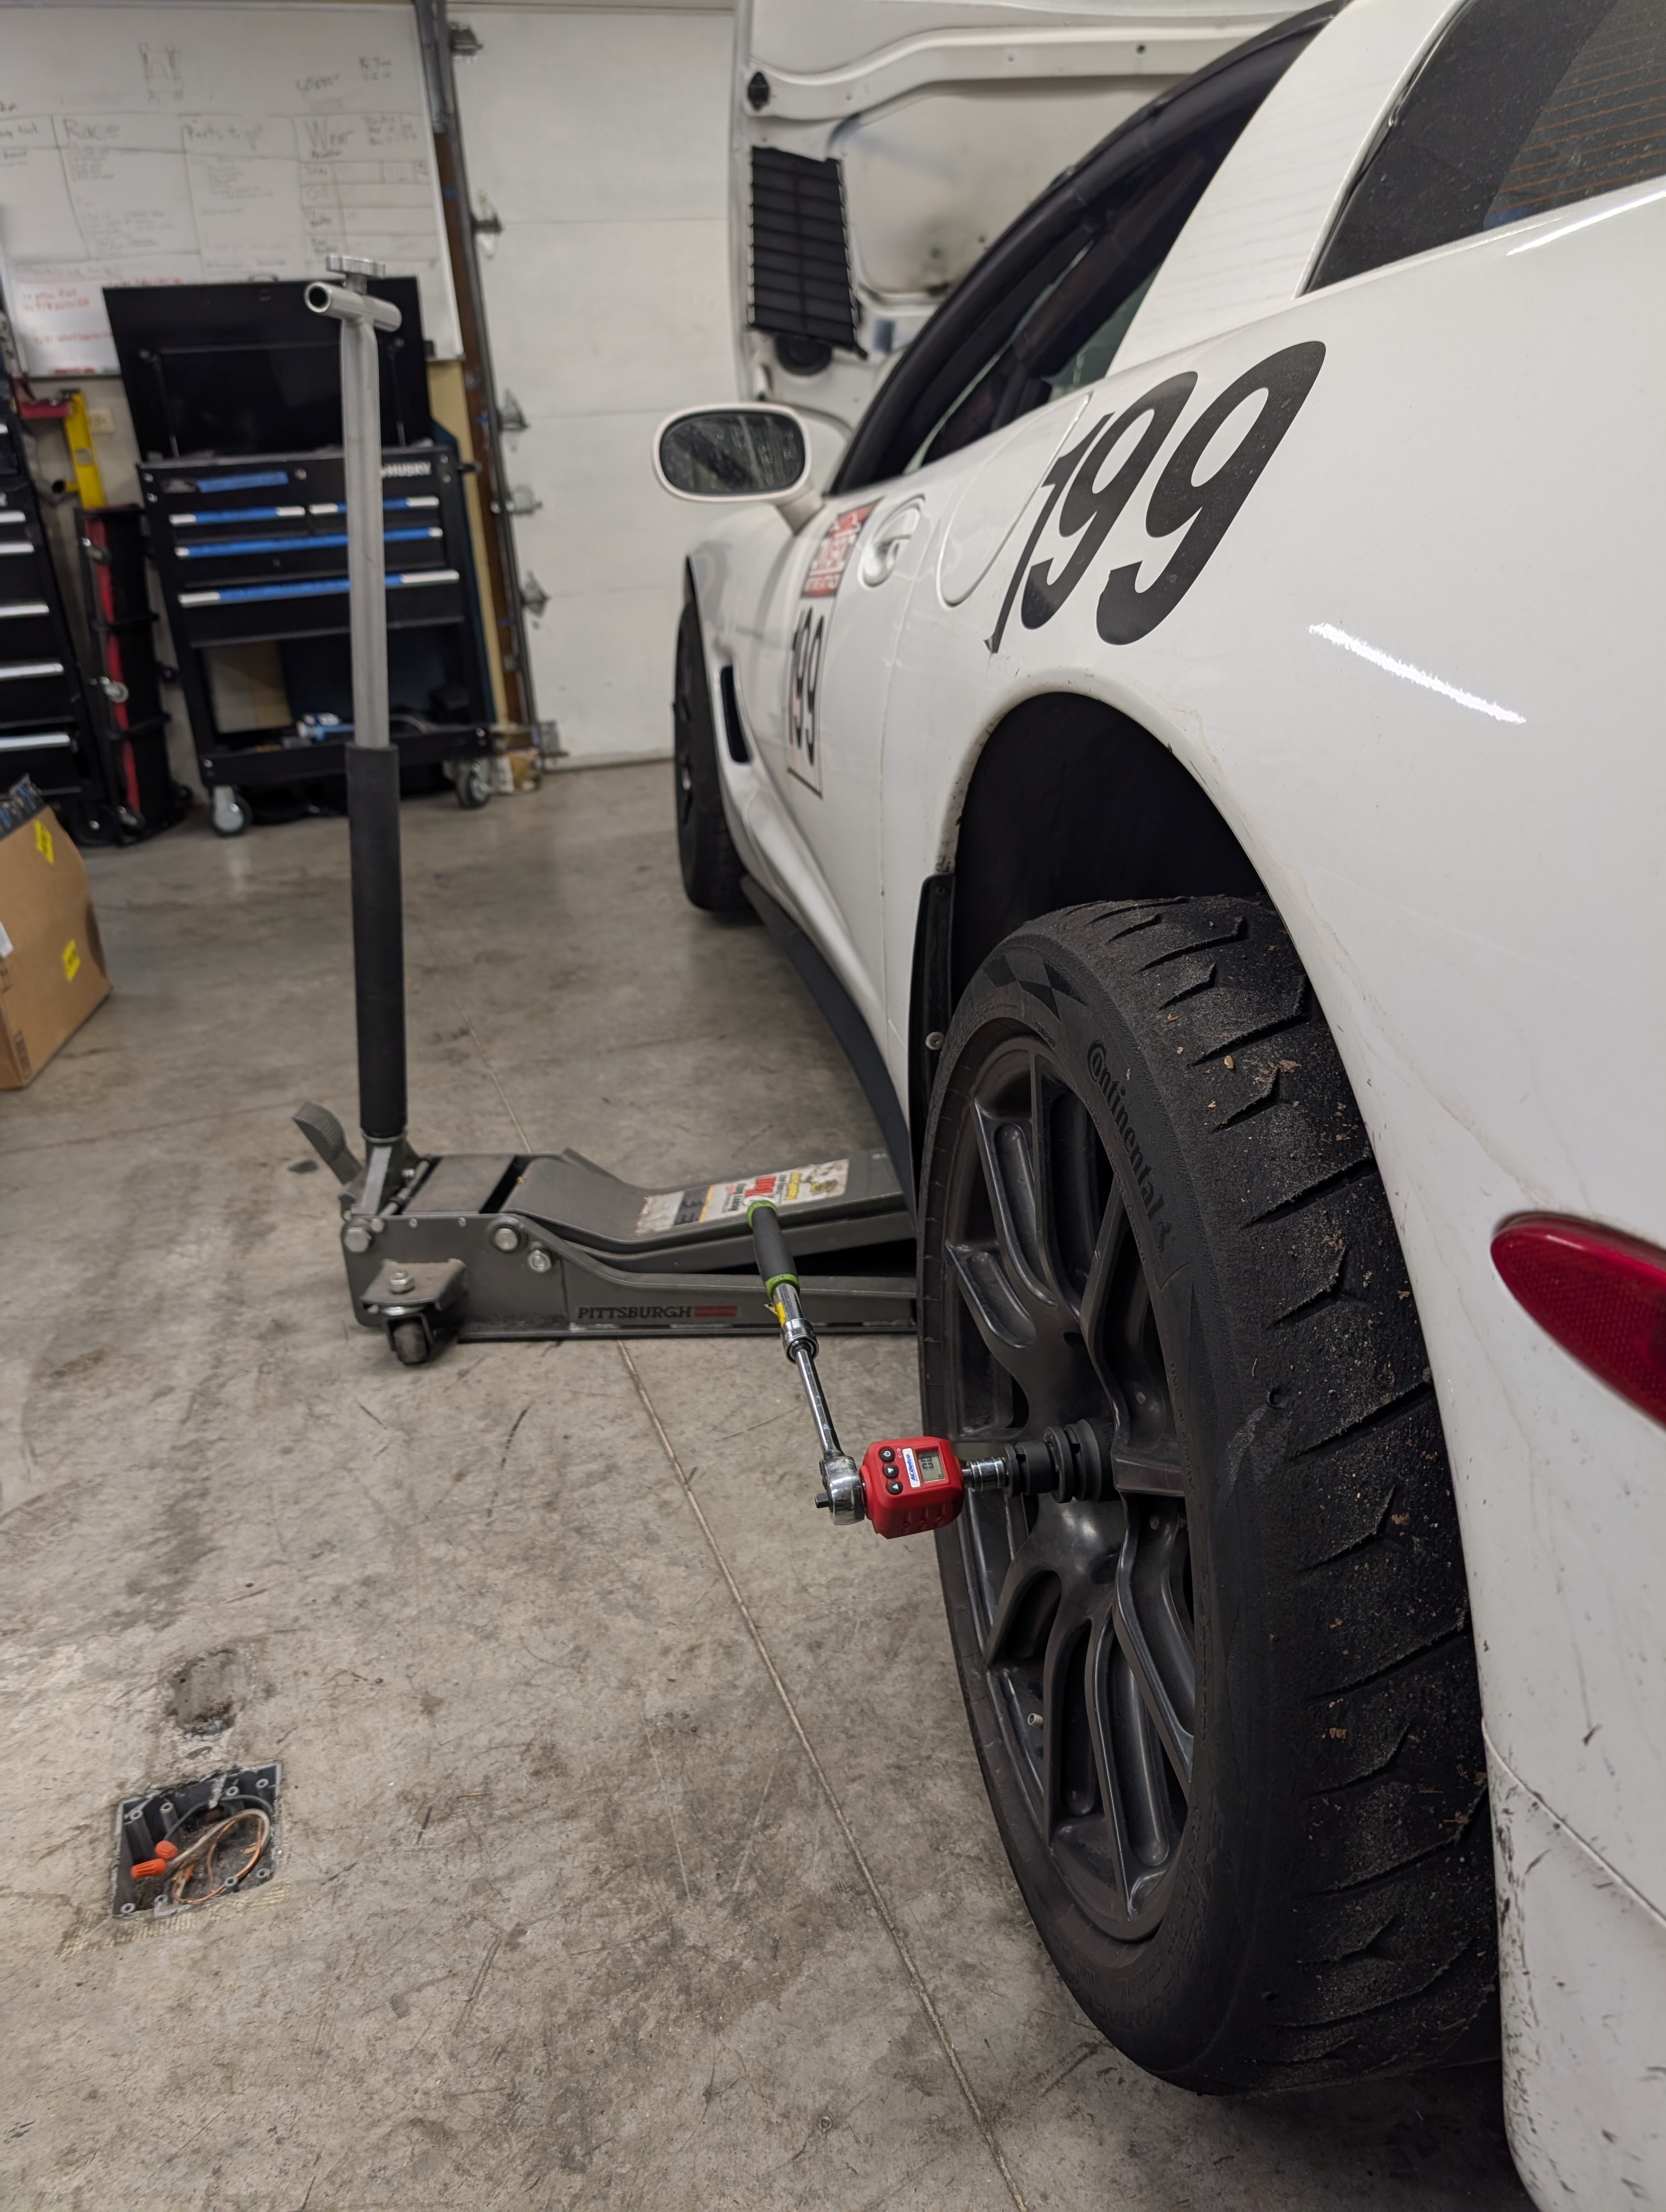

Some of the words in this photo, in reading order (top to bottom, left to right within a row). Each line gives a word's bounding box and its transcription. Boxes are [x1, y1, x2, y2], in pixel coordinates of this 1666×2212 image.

[983, 340, 1327, 654] 199
[1087, 1039, 1165, 1222] Continental
[578, 1304, 692, 1320] PITTSBURGH
